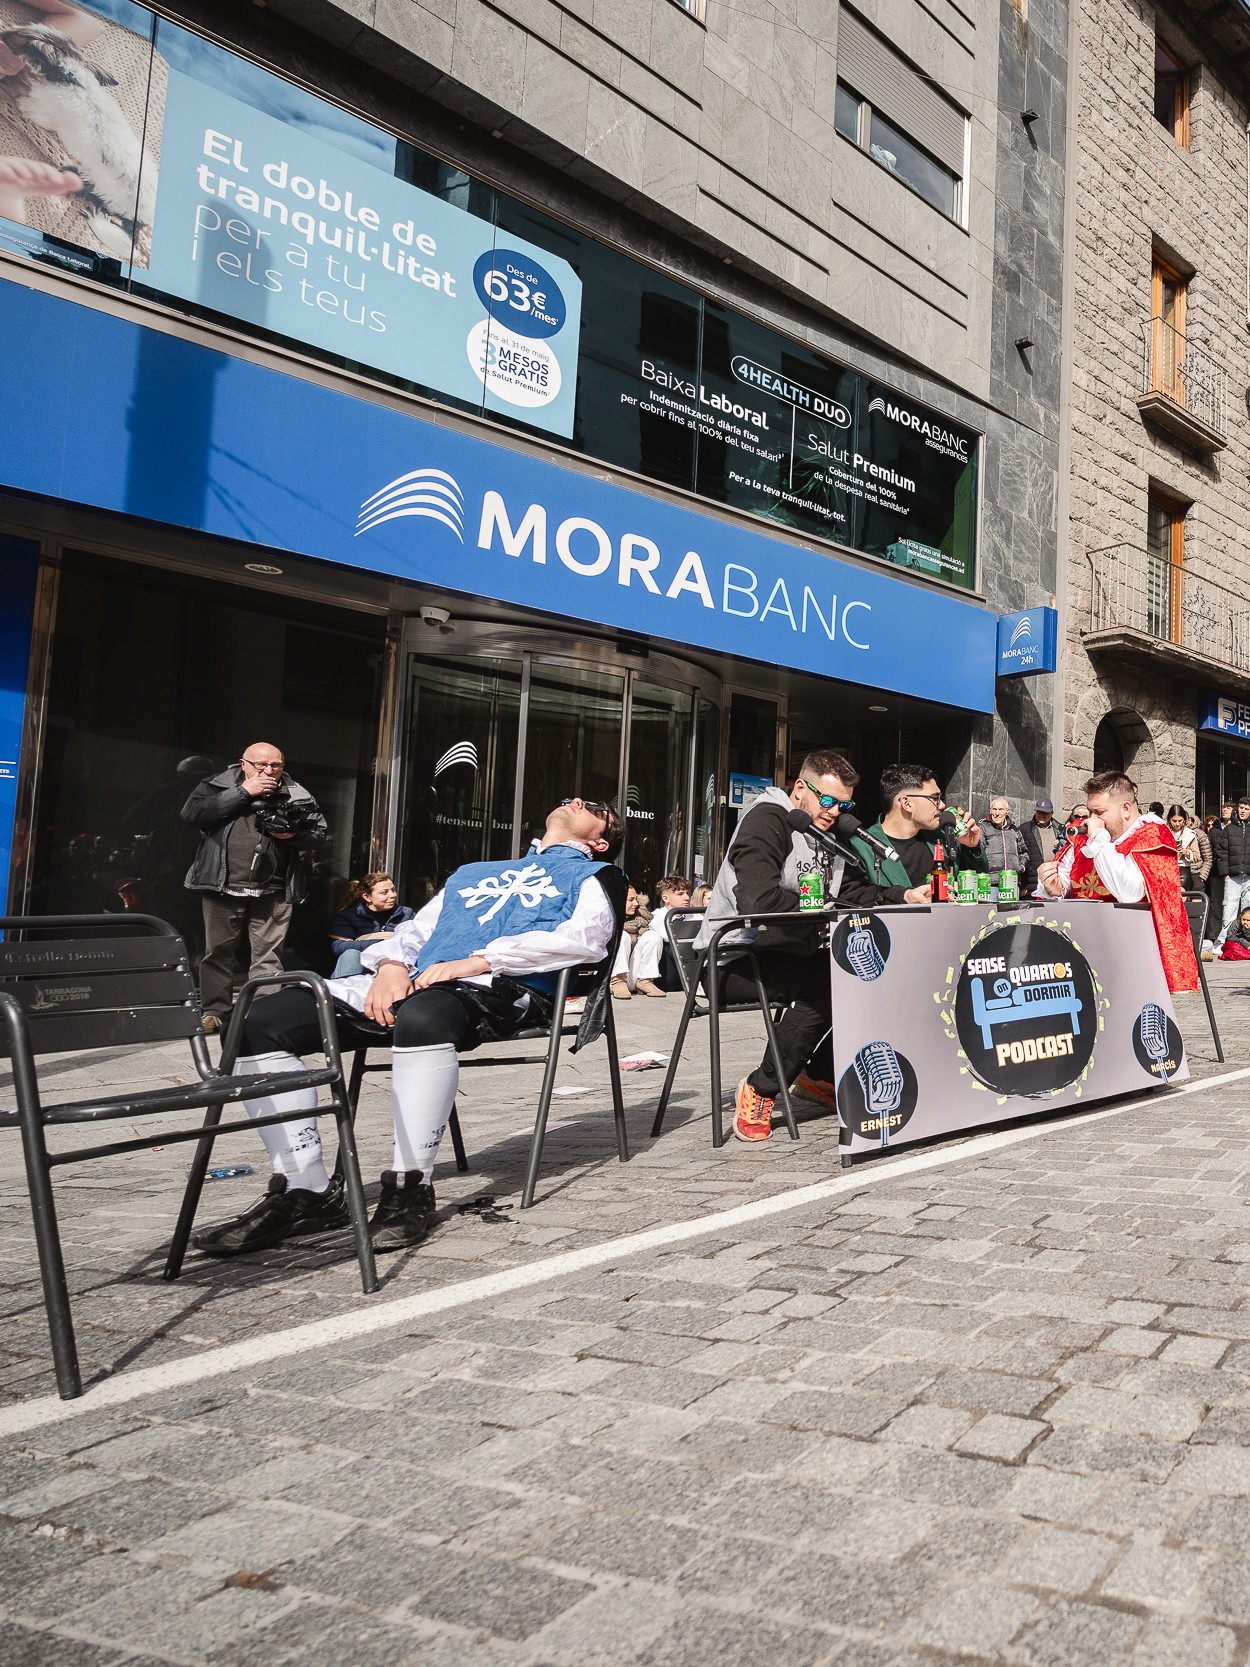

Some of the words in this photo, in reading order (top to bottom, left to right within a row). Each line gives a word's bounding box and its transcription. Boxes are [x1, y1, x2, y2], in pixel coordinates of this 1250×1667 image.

[203, 129, 249, 173] El
[262, 161, 381, 231] doble
[392, 220, 437, 257] de
[196, 163, 457, 298] tranquil·litat
[39, 245, 48, 253] de
[48, 249, 67, 261] Baixa
[194, 204, 272, 250] per
[285, 241, 309, 269] a
[326, 254, 366, 292] tu
[192, 233, 199, 261] i
[216, 251, 283, 293] els
[299, 278, 387, 333] teus
[506, 264, 525, 279] Des
[526, 273, 539, 285] de
[479, 339, 497, 365] 3
[499, 346, 549, 375] MESOS
[483, 329, 500, 341] Fns
[501, 337, 510, 346] al
[511, 340, 519, 349] 31
[521, 344, 531, 354] de
[532, 349, 550, 362] maig
[480, 366, 490, 375] de
[492, 370, 513, 384] Salut
[498, 359, 549, 387] GRATIS
[641, 359, 697, 399] Baixa
[700, 385, 770, 431] Laboral
[737, 362, 810, 408] 4HEALTH
[813, 397, 847, 424] DUO
[620, 393, 638, 406] per
[639, 401, 667, 418] cobrir
[668, 411, 685, 426] fins
[687, 419, 697, 431] al
[699, 423, 723, 441] 100%
[724, 435, 739, 448] del
[741, 441, 755, 454] teu
[649, 390, 715, 425] Indemnització
[717, 419, 742, 436] diària
[743, 429, 760, 443] fixa
[886, 402, 968, 455] MORABANC
[807, 433, 850, 466] Salut
[853, 453, 917, 493] Premium
[925, 437, 969, 465] assegurances
[728, 471, 743, 483] Per
[745, 477, 751, 486] a
[752, 479, 761, 490] la
[762, 483, 781, 497] teva
[813, 471, 824, 481] de
[825, 474, 834, 485] la
[834, 478, 863, 498] despesa
[864, 492, 878, 504] real
[829, 465, 865, 487] Cobertura
[866, 481, 878, 492] del
[878, 486, 897, 500] 100%
[477, 490, 872, 650] MORABANC
[1002, 644, 1039, 659] MORABANC
[1020, 655, 1034, 665] 24h
[848, 914, 871, 929] FELIU
[967, 956, 1006, 976] SENSE
[44, 986, 93, 996] TARRAGONA
[70, 992, 90, 1001] 2018
[1023, 984, 1072, 1003] DORMIR
[995, 1032, 1075, 1067] PODCAST
[1150, 1059, 1176, 1072] NARCÍS
[860, 1113, 903, 1132] ERNEST
